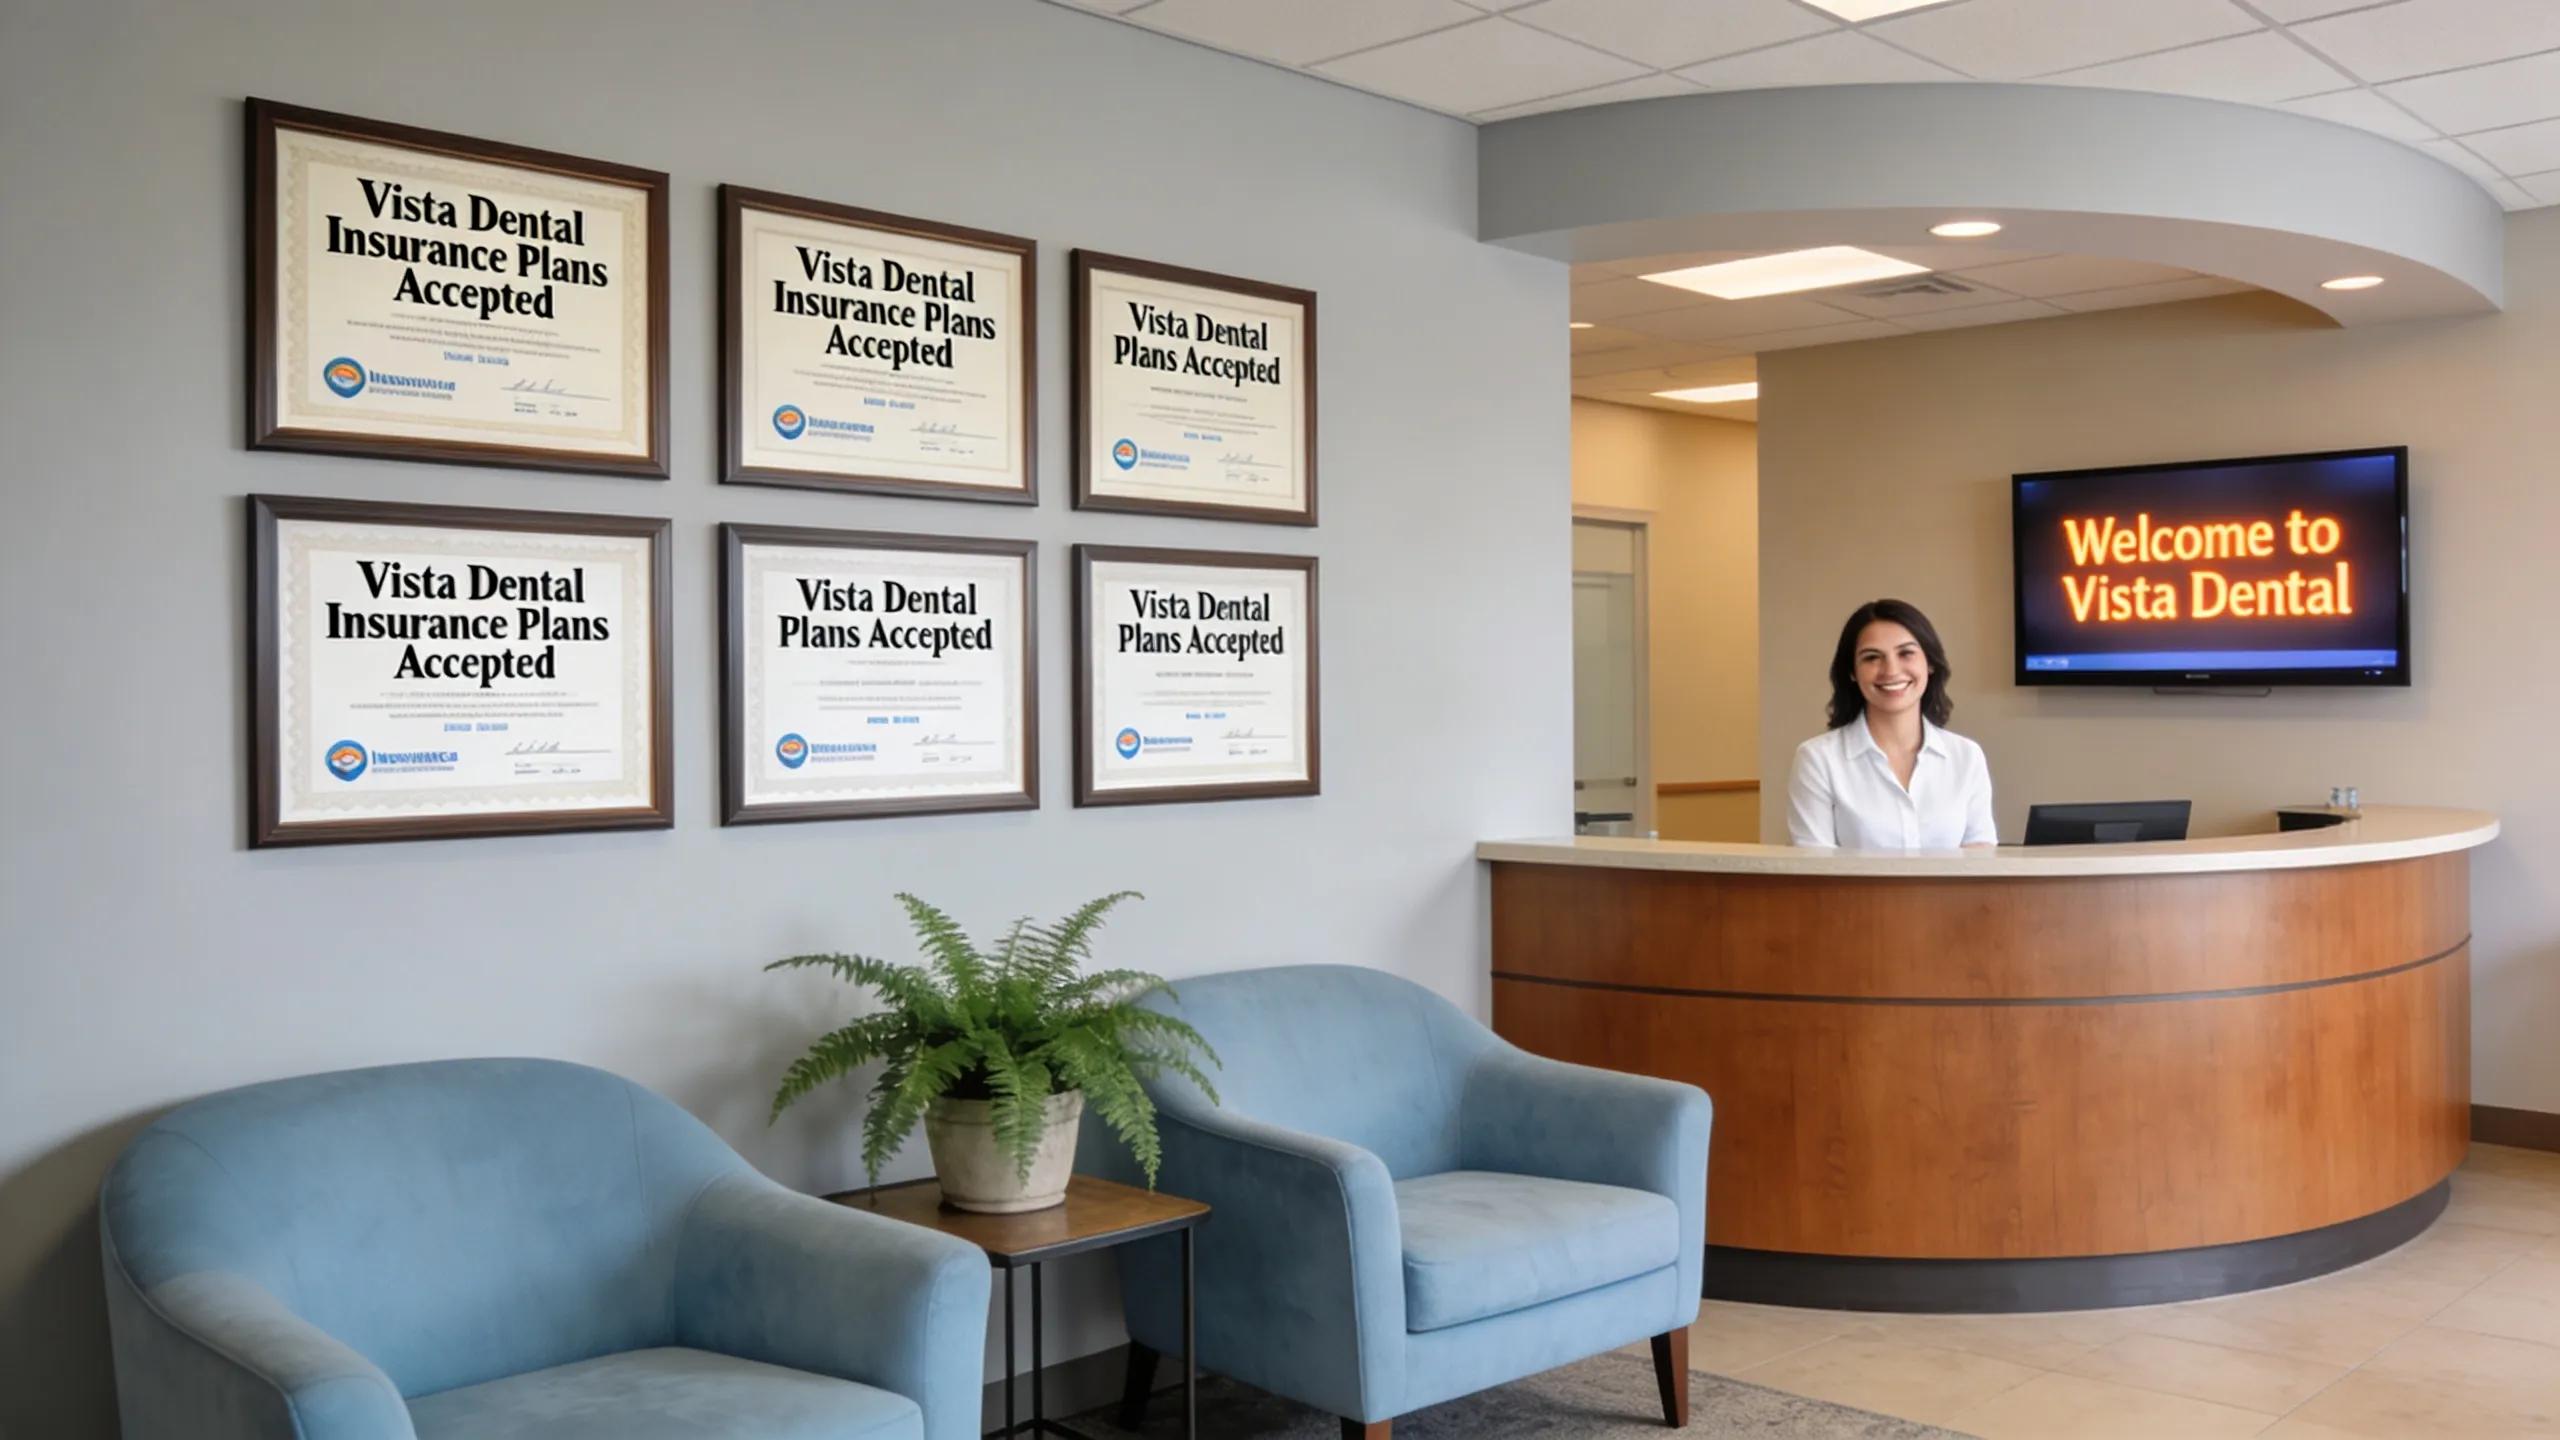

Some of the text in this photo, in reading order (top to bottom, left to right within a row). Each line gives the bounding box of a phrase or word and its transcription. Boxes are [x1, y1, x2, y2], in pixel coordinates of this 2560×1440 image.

[357, 178, 585, 246] Vista Dental
[326, 215, 608, 287] Insurance Plans
[795, 246, 975, 303] Vista Dental
[393, 267, 554, 320] Accepted
[774, 280, 996, 340] Insurance Plans
[825, 324, 954, 371] Accepted
[1129, 301, 1268, 351] Vista Dental
[1114, 334, 1280, 388] Plans Accepted
[2063, 510, 2341, 567] Welcome to
[357, 560, 585, 603] Vista Dental
[796, 578, 977, 615] Vista Dental
[1130, 589, 1270, 622] Vista Dental
[2062, 561, 2353, 622] Vista Dental
[326, 602, 610, 641] Insurance Plans
[779, 615, 993, 658] Plans Accepted
[1118, 623, 1284, 662] Plans Accepted
[394, 644, 556, 689] Accepted
